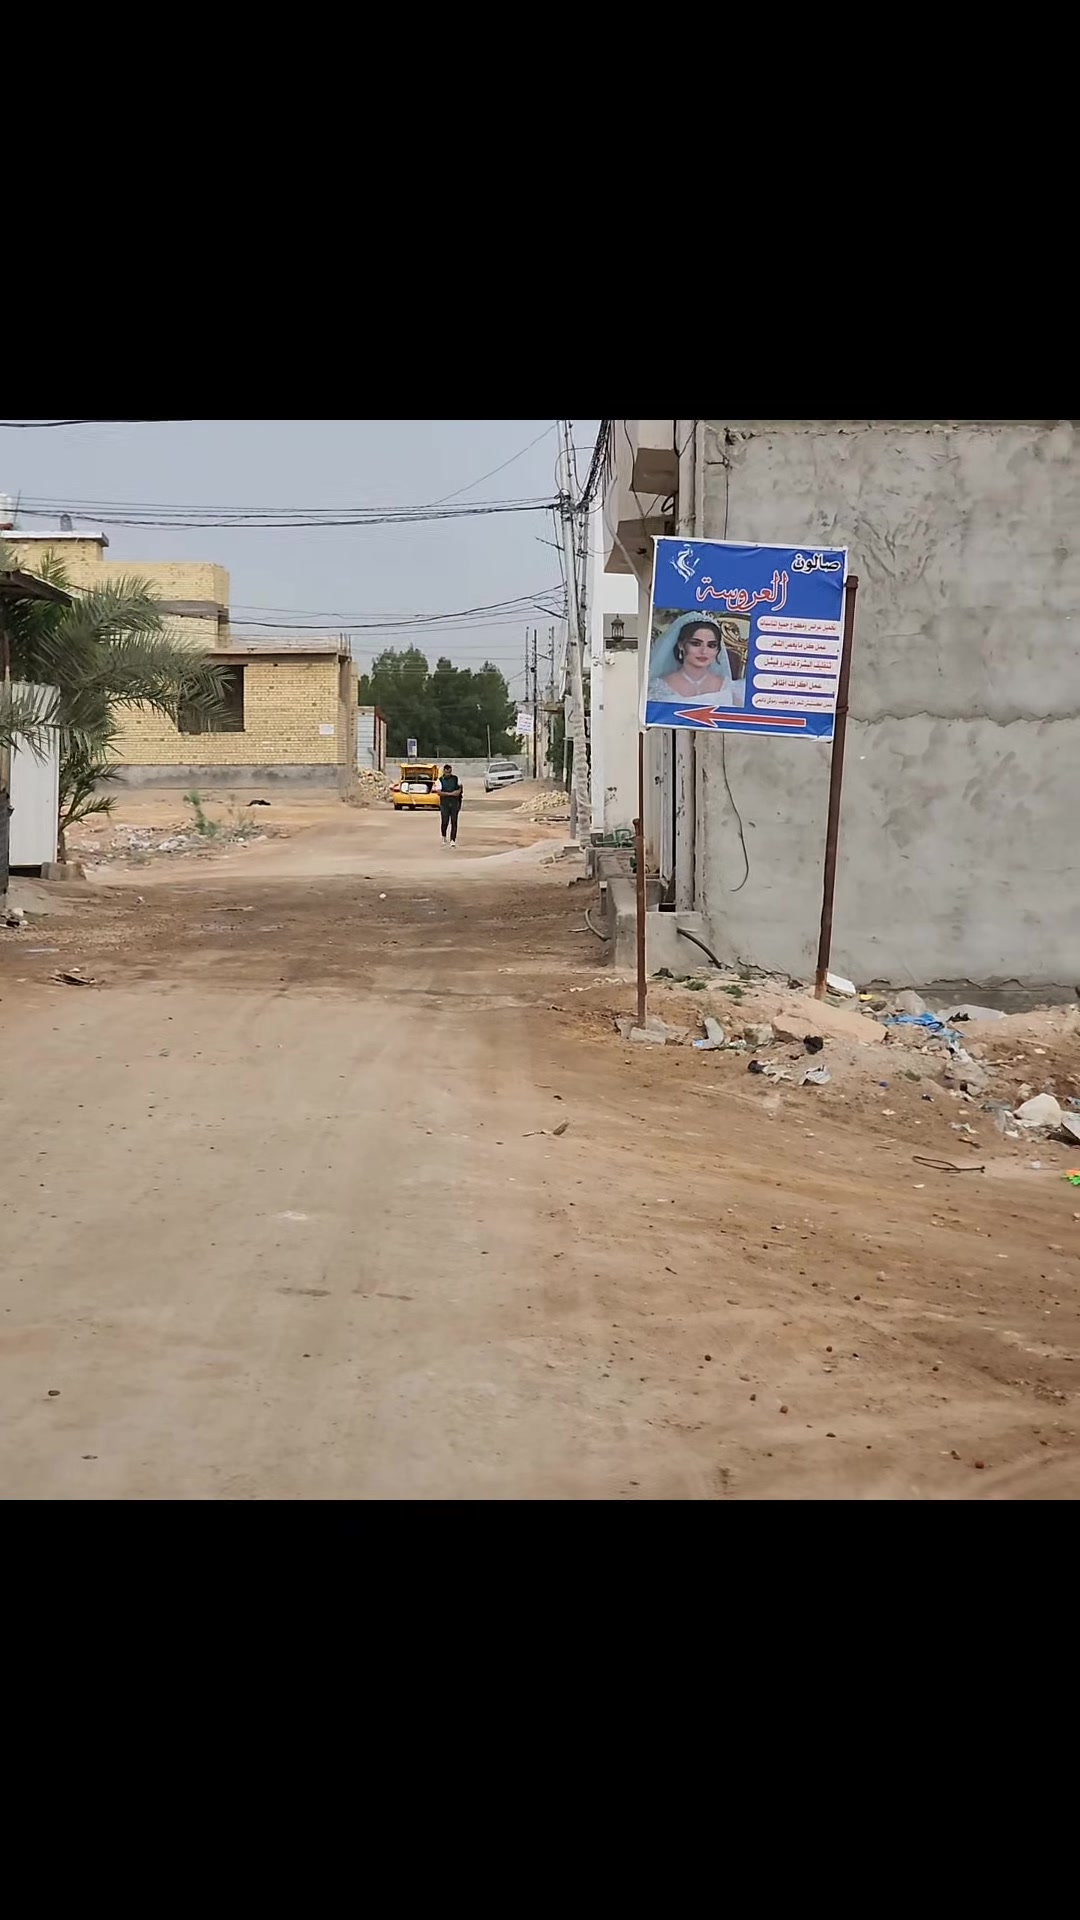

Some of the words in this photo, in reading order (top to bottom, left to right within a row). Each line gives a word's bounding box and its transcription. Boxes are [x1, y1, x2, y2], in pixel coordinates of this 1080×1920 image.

[792, 554, 840, 574] صالون
[696, 570, 788, 611] العروسة
[808, 682, 822, 690] عمل
